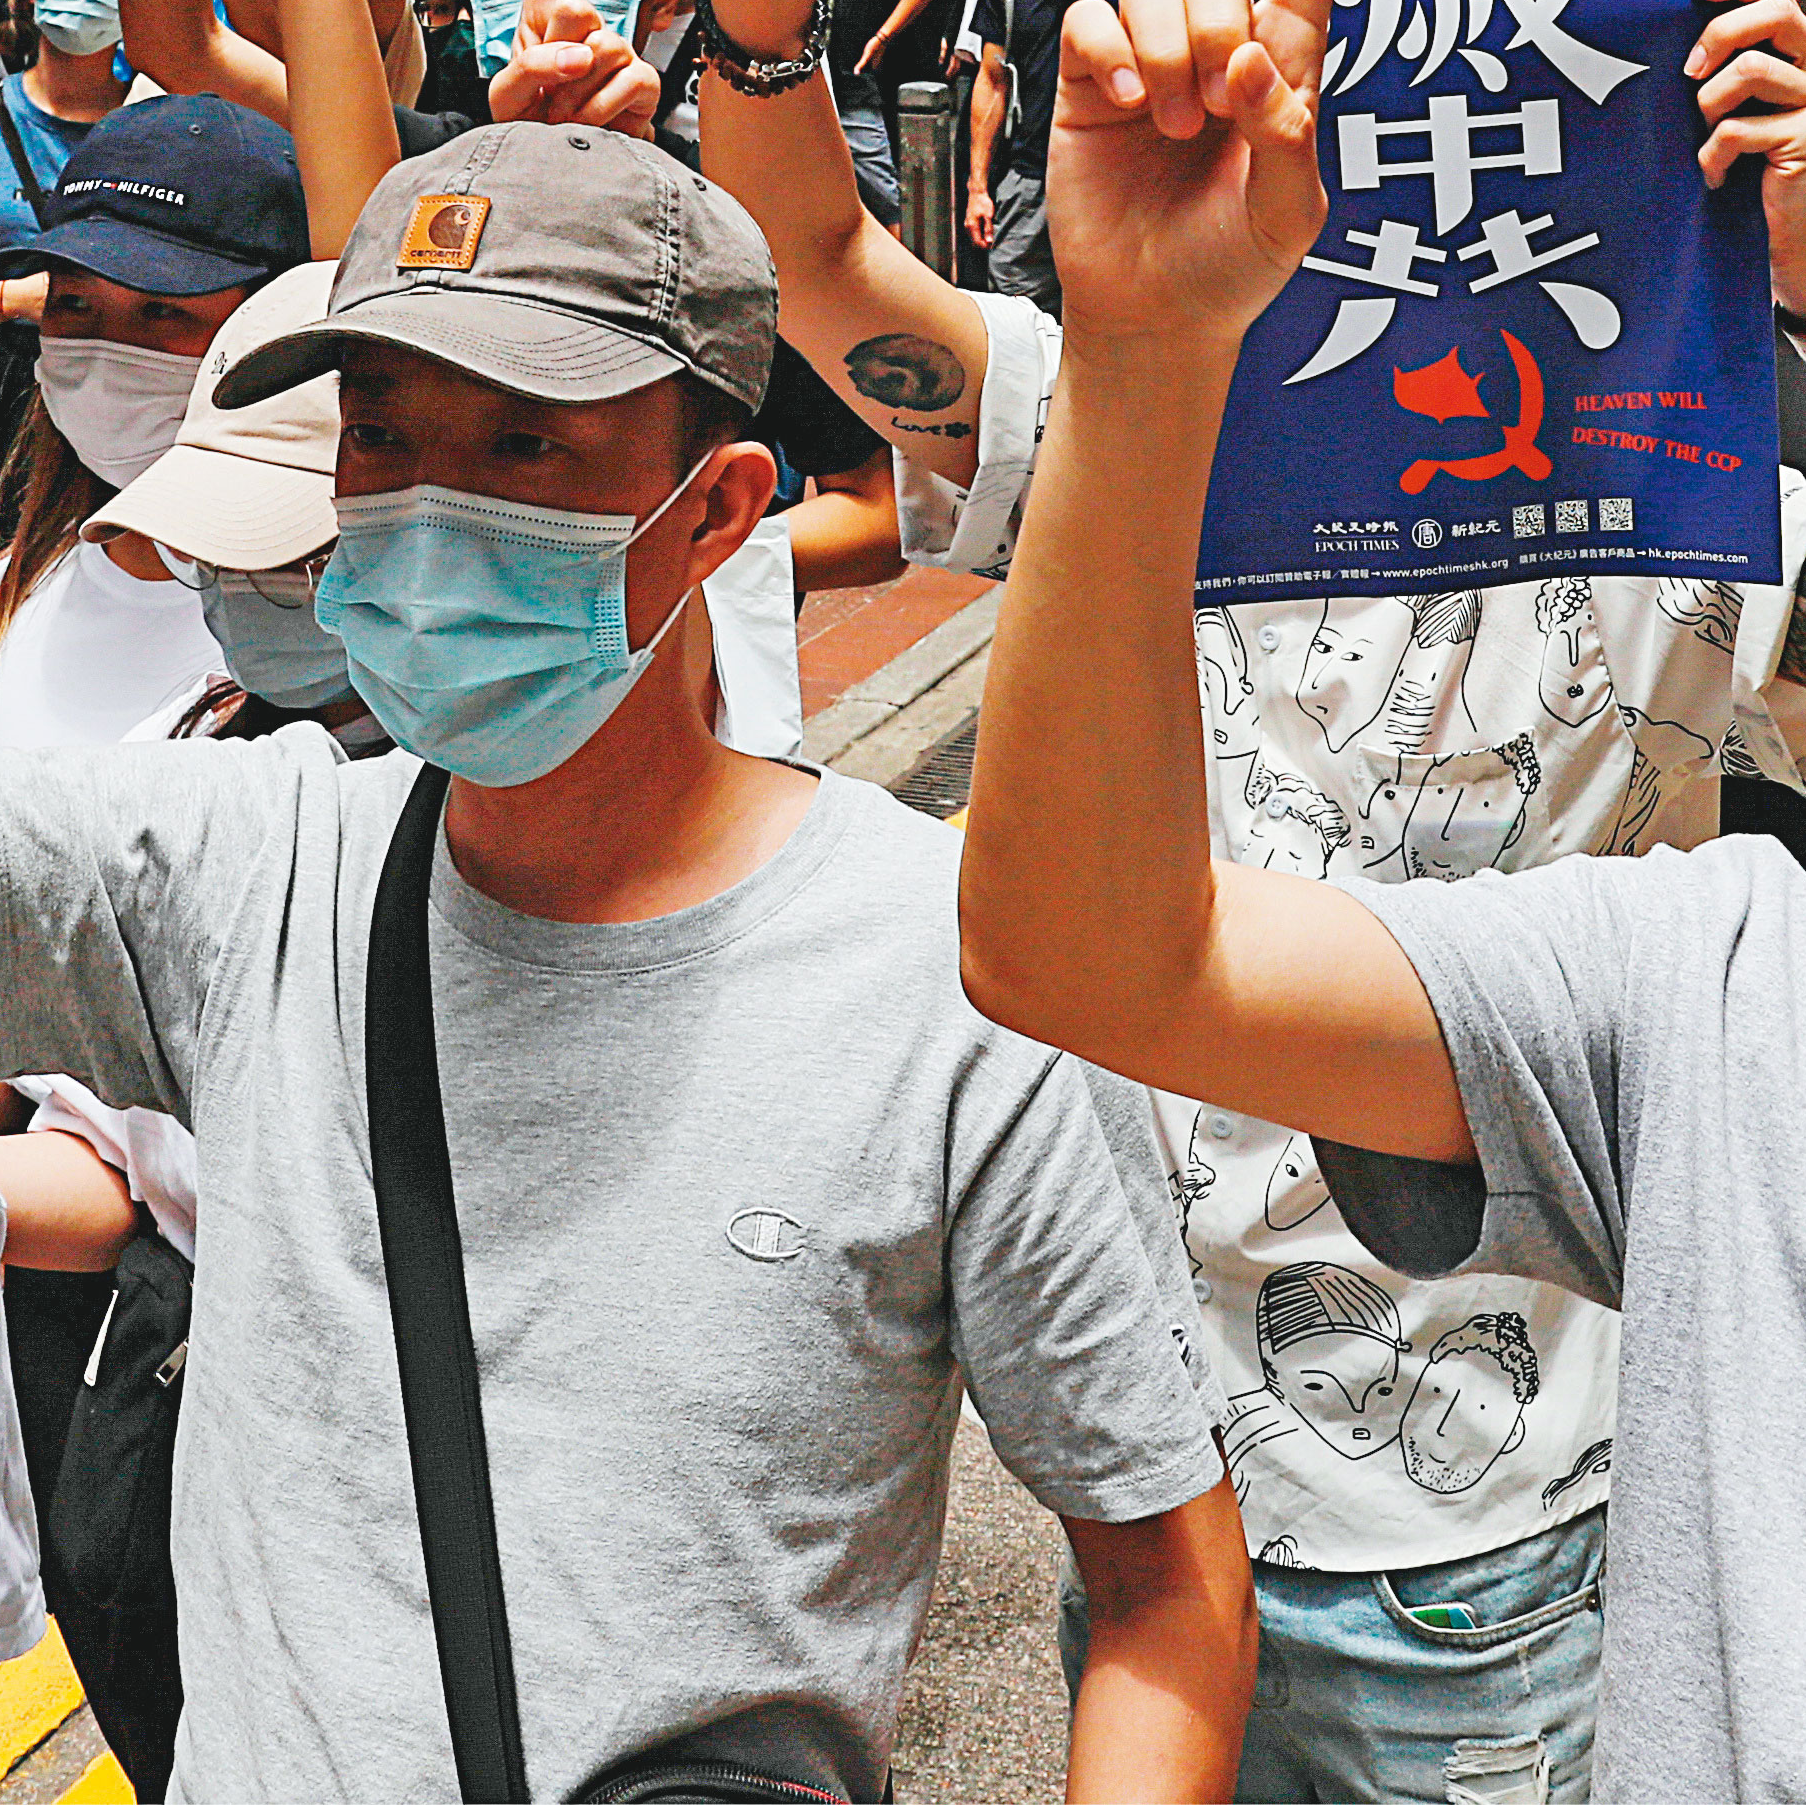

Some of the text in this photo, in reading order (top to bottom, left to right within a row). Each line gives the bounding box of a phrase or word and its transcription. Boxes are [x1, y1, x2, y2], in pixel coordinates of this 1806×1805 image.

[63, 179, 185, 205] TOMMY HILFIGER
[1575, 391, 1708, 413] HEAVEN WILL
[1571, 426, 1743, 473] DESTROY THE CCP
[1315, 539, 1400, 553] EPOCH TIMES
[1648, 547, 1749, 564] hk.epochtimes.com
[1383, 557, 1509, 579] www.epochtimeshk.org
